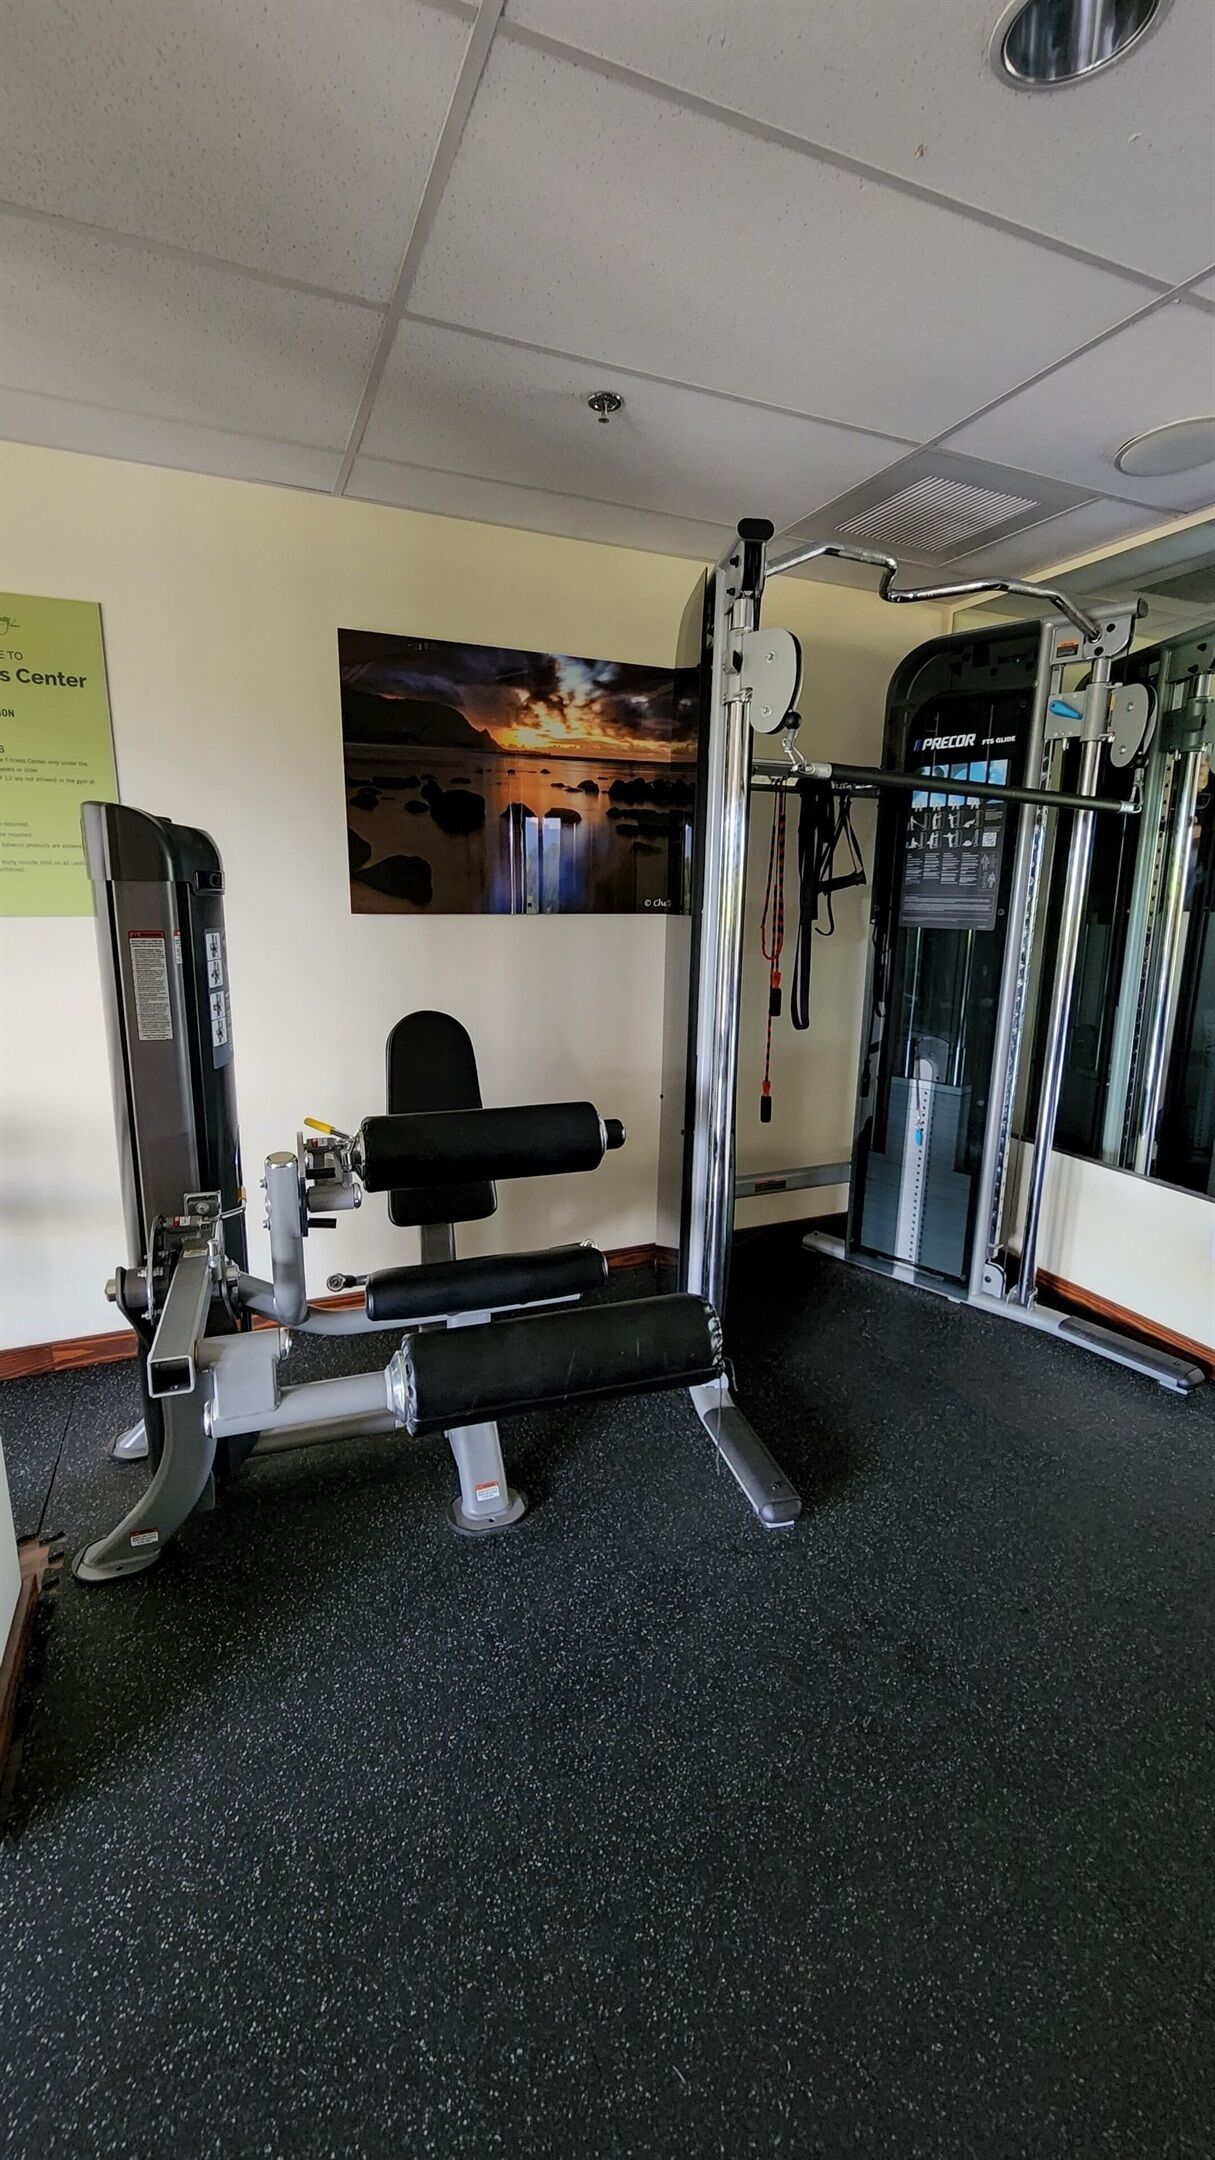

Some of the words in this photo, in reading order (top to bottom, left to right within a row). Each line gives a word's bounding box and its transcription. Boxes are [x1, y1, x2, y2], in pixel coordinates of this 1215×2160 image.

[7, 651, 23, 660] TO
[16, 668, 87, 688] Center
[0, 709, 15, 718] ON
[922, 733, 976, 751] PRECOR
